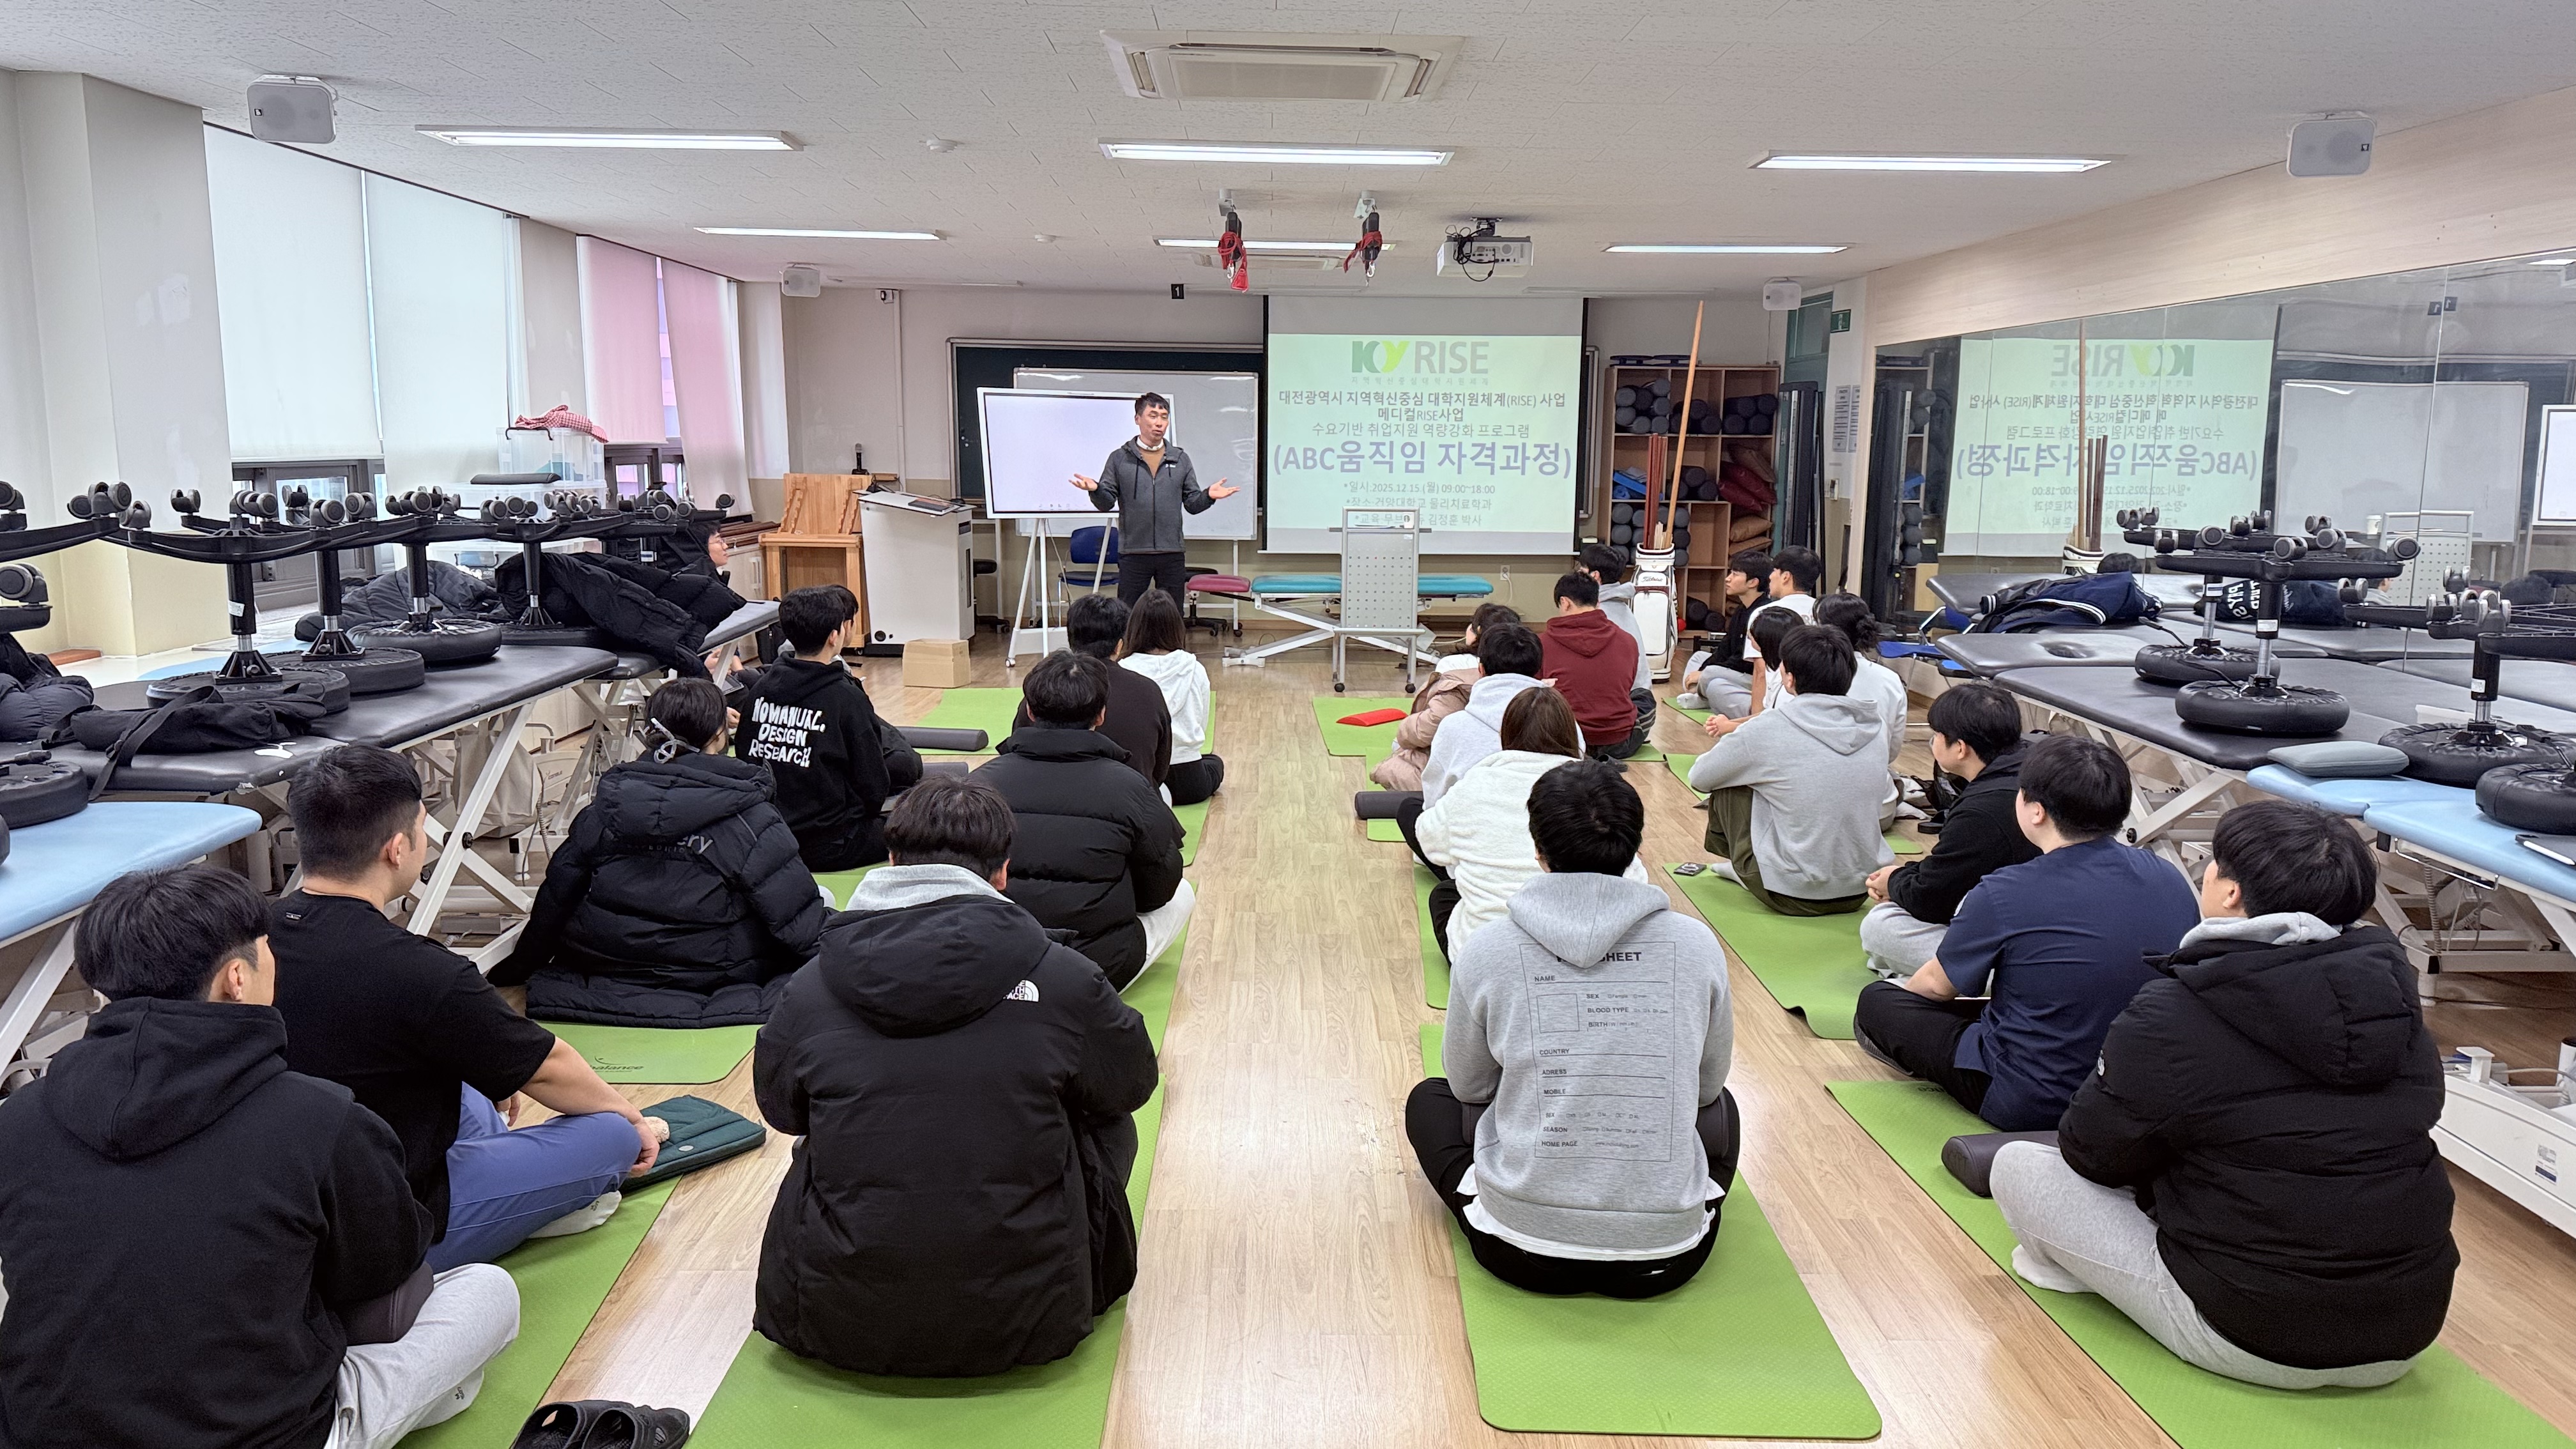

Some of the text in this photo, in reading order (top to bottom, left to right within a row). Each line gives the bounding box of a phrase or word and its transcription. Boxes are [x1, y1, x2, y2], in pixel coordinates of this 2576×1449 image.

[1414, 341, 1489, 374] RISE
[1279, 390, 1565, 408] 대전광역시 지역혁신중심 대학지원체계(RISE) 사업
[1378, 407, 1464, 422] 메디컬RISE사업
[1312, 422, 1529, 439] 수요기반 취업지원 역량강화 프로그램
[1274, 440, 1571, 479] (ABC움직임 자격과정)
[1429, 498, 1492, 510] 물리치료학과
[1428, 514, 1458, 526] 김정훈
[1461, 514, 1482, 526] 박사
[758, 724, 808, 747] DESIGN
